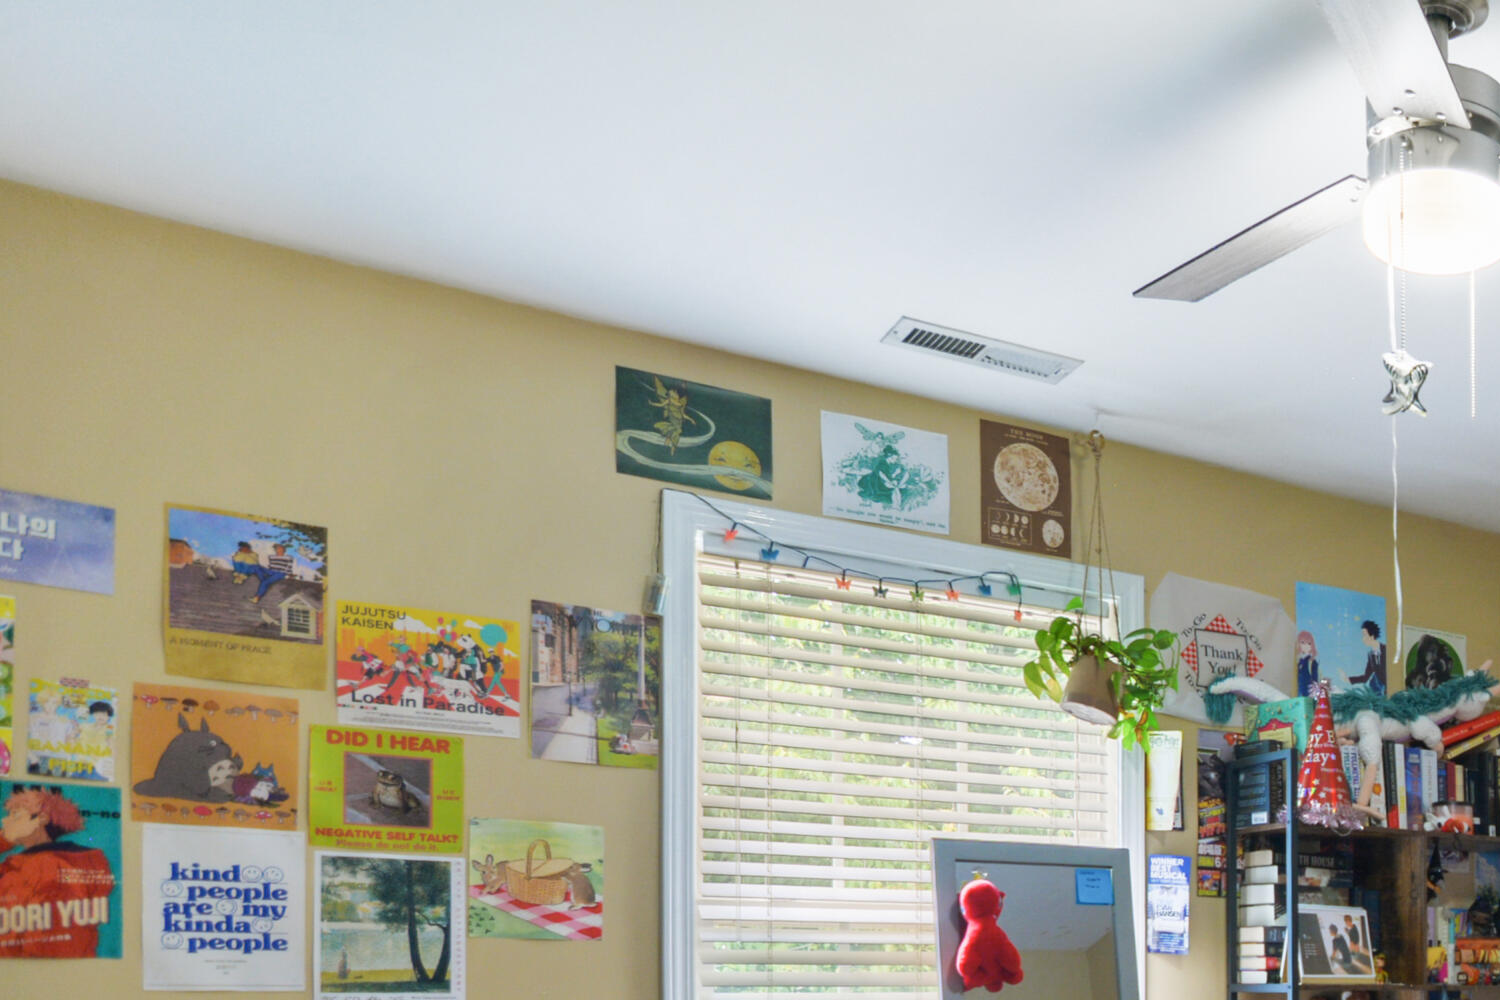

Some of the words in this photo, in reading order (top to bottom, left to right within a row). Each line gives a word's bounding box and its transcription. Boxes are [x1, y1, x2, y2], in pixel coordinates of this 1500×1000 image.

[342, 605, 406, 620] JUJUTSU
[341, 617, 394, 631] KAISEN
[1181, 613, 1207, 638] To-Go
[226, 641, 239, 650] OF
[1200, 645, 1243, 661] Thank
[351, 689, 396, 706] Lost
[400, 695, 416, 708] in
[423, 697, 505, 716] Paradise
[28, 738, 112, 757] BANANA
[326, 729, 368, 747] DID
[376, 733, 383, 748] I
[390, 734, 450, 754] HEAR
[49, 758, 94, 775] FISH
[315, 827, 382, 840] NEGATIVE
[387, 831, 416, 841] SELF
[420, 832, 459, 843] TALK?
[336, 839, 373, 848] Please
[376, 841, 389, 849] do
[170, 861, 241, 882] kind
[187, 882, 288, 903] people
[56, 896, 109, 928] YUJI
[163, 902, 213, 918] are
[242, 905, 287, 921] my
[163, 912, 252, 933] kinda
[187, 932, 288, 954] people
